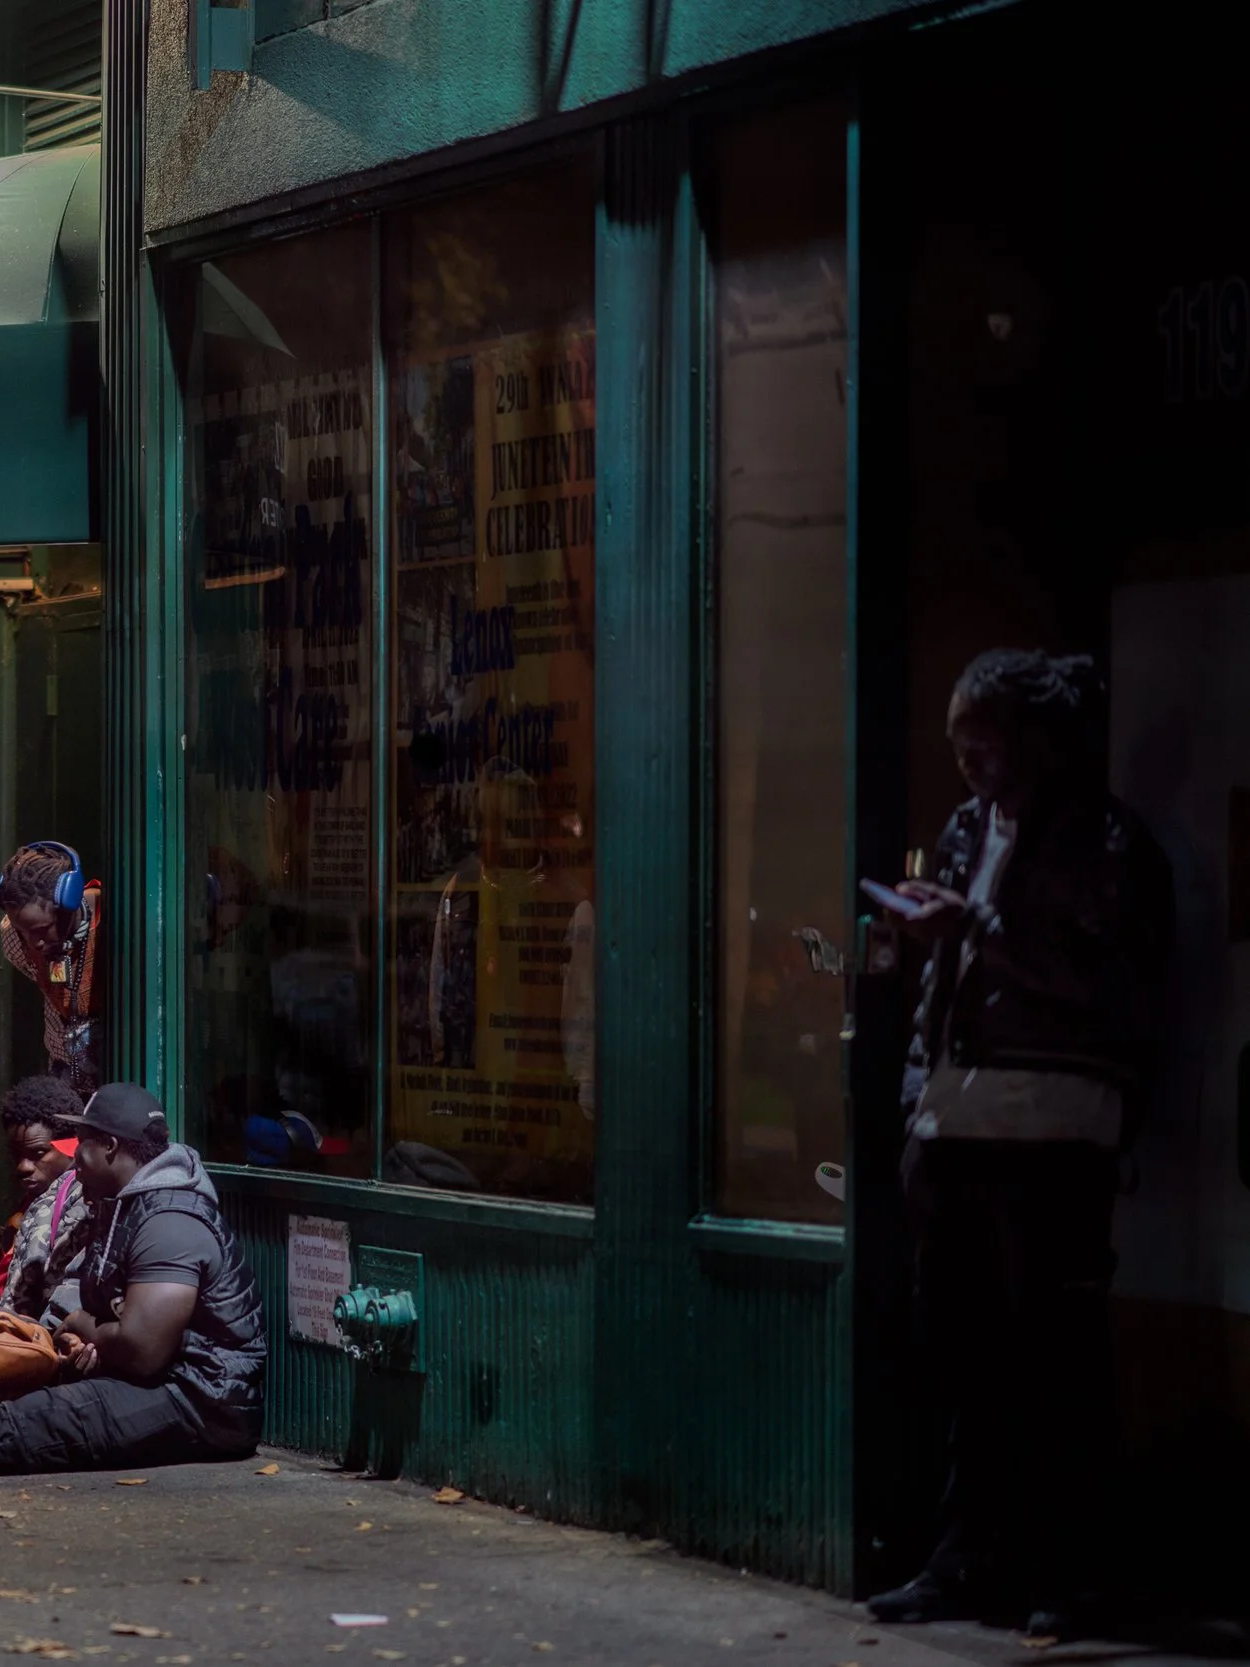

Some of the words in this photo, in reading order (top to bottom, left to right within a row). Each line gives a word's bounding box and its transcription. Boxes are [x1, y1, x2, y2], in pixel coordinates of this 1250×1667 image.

[495, 370, 529, 415] 29th
[450, 594, 515, 676] Lenox
[483, 697, 554, 778] Center
